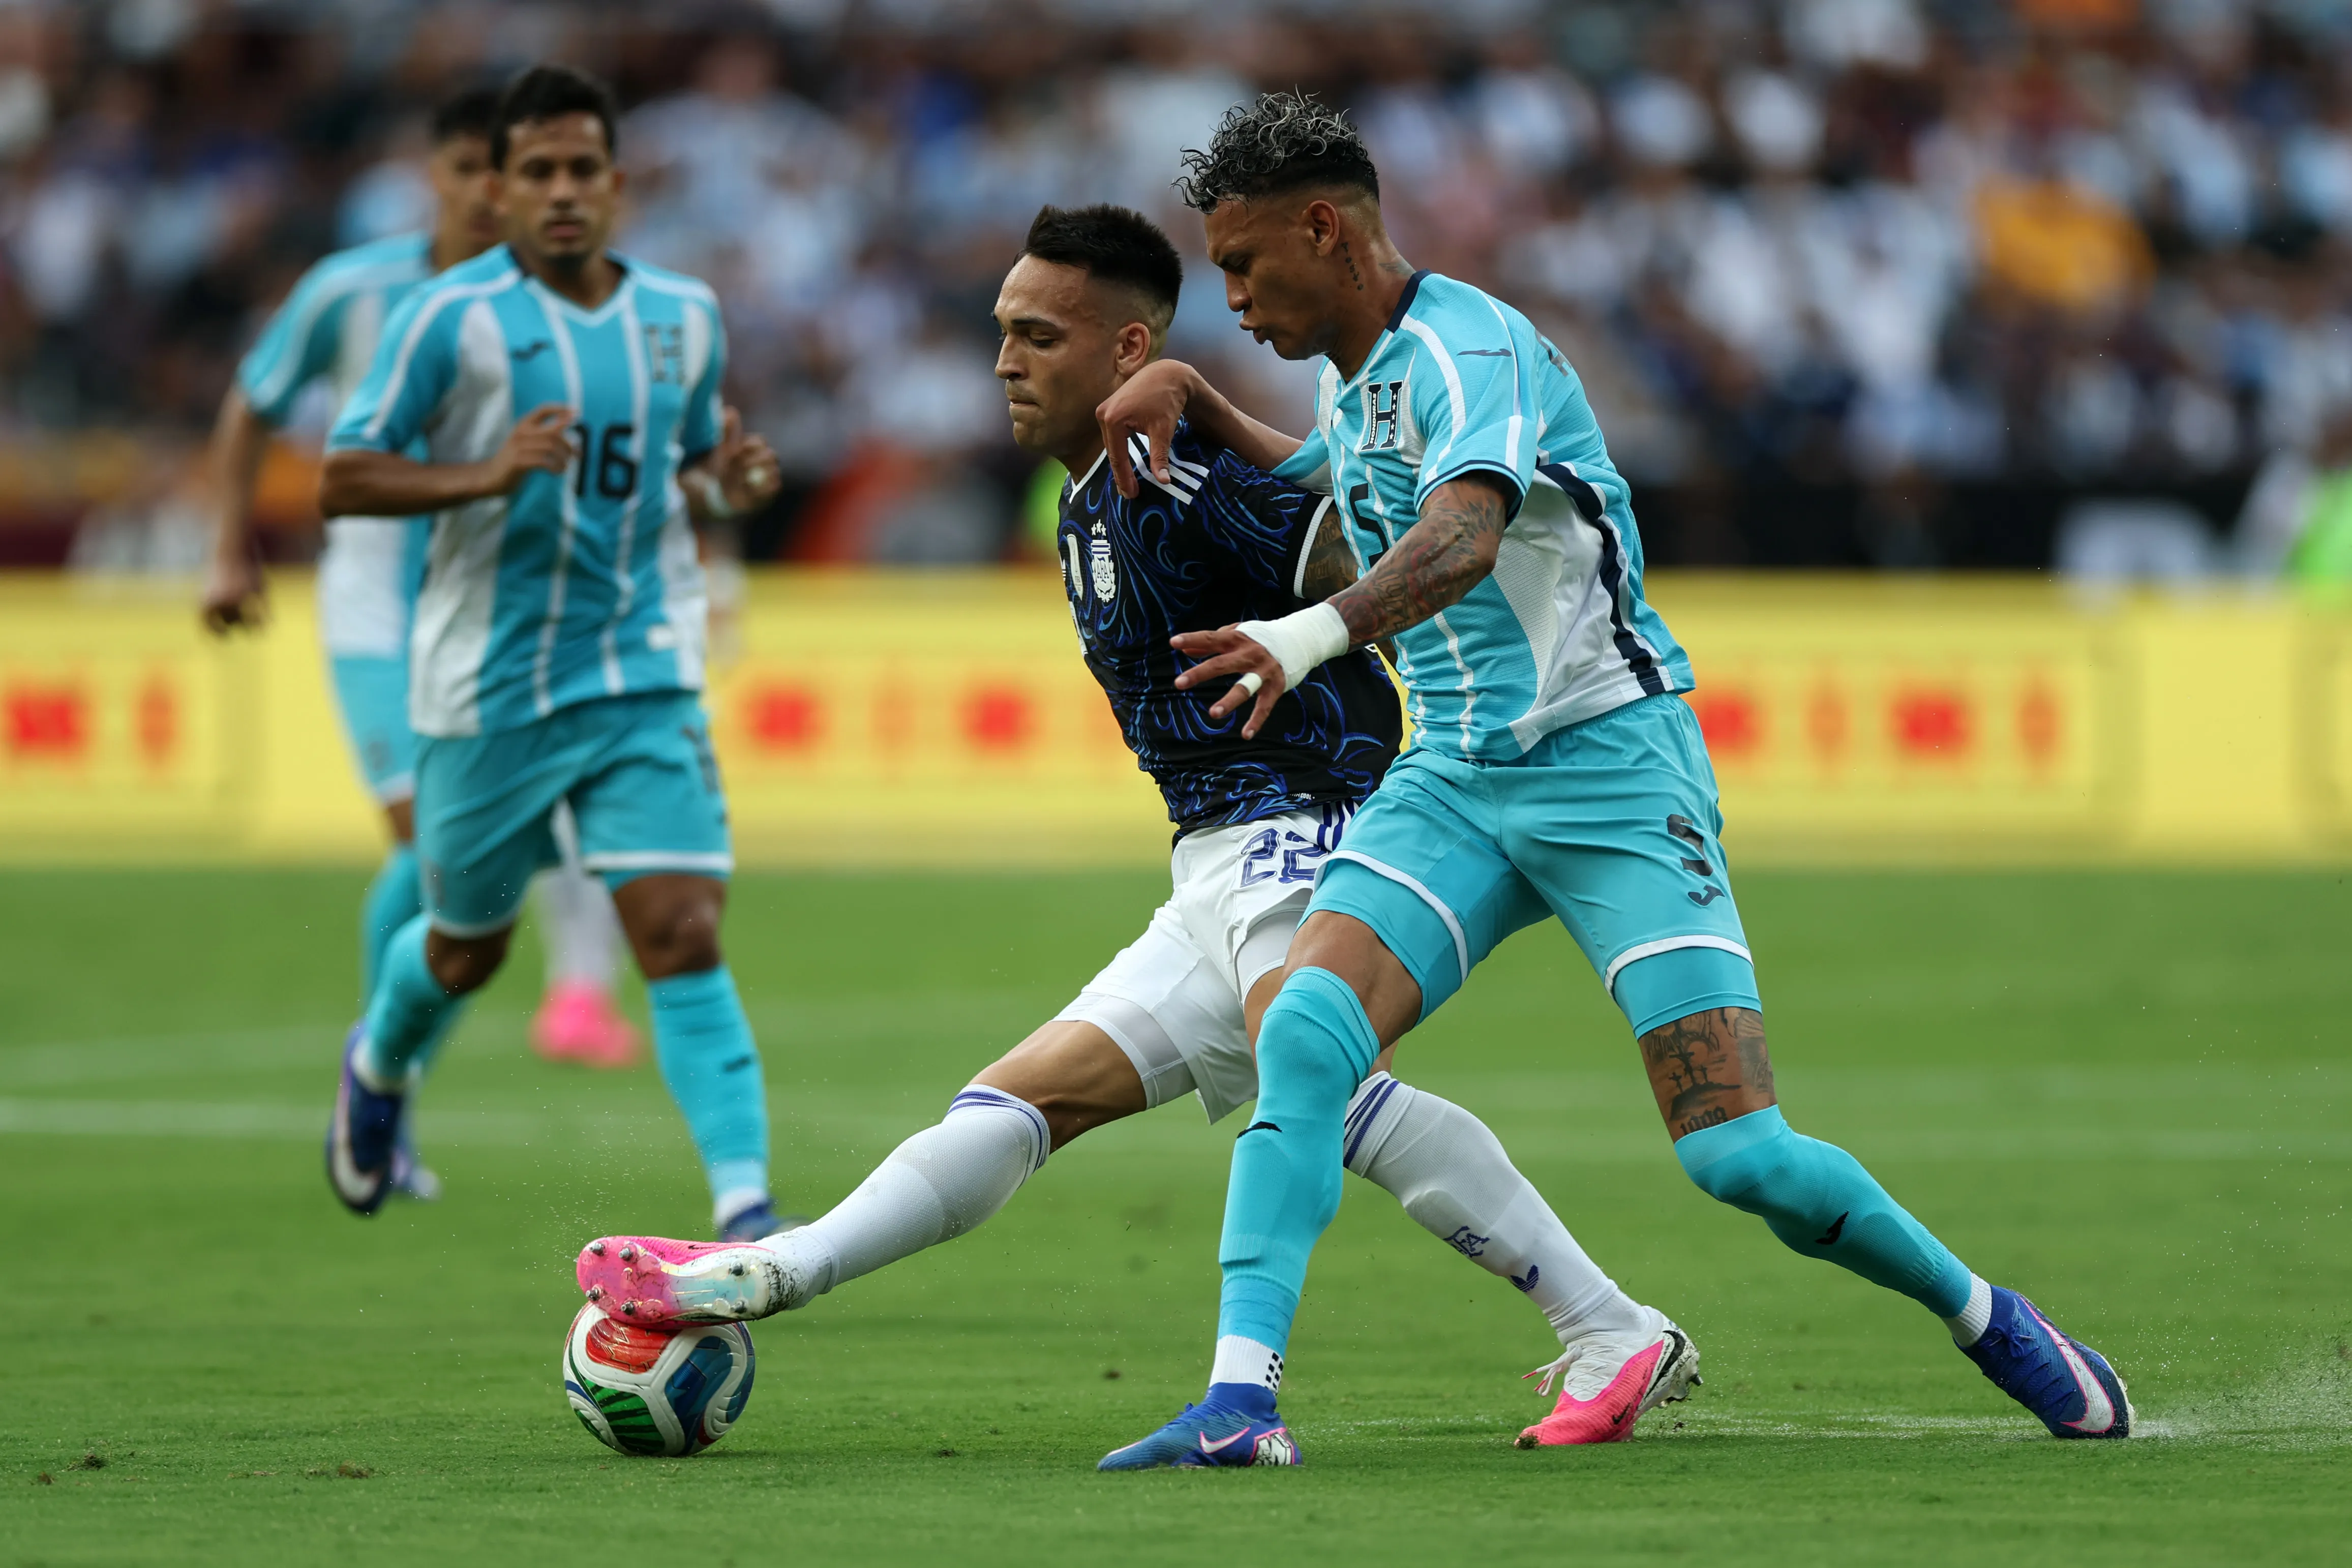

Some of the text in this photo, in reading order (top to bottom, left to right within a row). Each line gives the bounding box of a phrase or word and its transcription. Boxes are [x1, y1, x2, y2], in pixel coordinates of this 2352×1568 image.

[1360, 380, 1403, 452] H
[573, 422, 637, 497] 16
[1349, 483, 1389, 568] 5
[1241, 828, 1329, 888] 22
